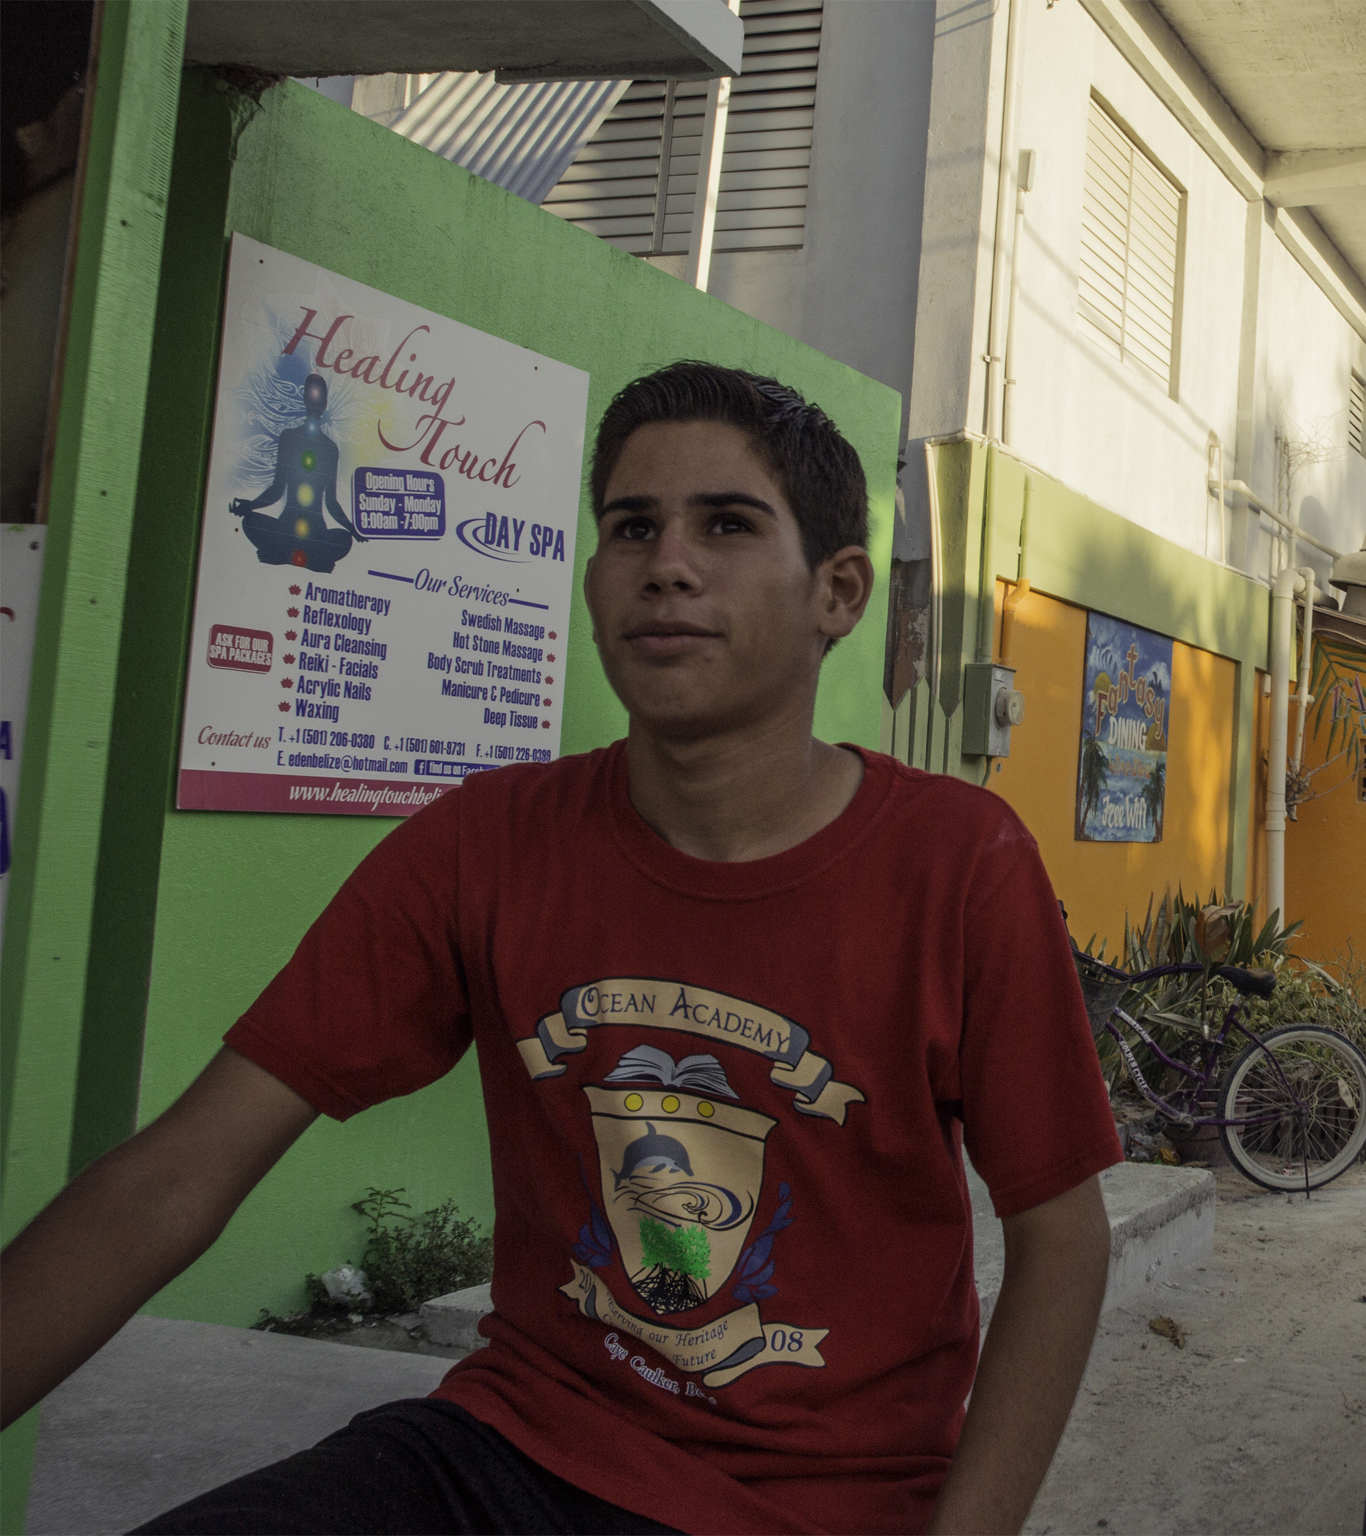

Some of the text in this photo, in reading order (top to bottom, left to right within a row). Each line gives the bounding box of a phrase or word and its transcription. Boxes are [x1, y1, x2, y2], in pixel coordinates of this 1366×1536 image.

[282, 305, 456, 421] Healing
[378, 414, 547, 488] Touch
[366, 472, 434, 492] Opening Hours
[359, 493, 396, 514] Sunday
[404, 495, 441, 514] Monday
[360, 512, 398, 530] 9:00am
[484, 511, 565, 562] DAY SPA
[304, 582, 391, 616] Aromatherapy
[414, 568, 510, 607] Our Services
[303, 605, 371, 635] Reflexology
[461, 609, 545, 640] Swedish Massage
[210, 645, 272, 666] SPA PACKAGES
[215, 633, 269, 652] ASK FOR OUR
[301, 628, 387, 661] Aura Cleansing
[453, 631, 543, 663] Hot Stone Massage
[298, 651, 328, 673] Reiki
[339, 656, 378, 680] Facials
[427, 652, 541, 684] Body Scrub Treatments
[296, 675, 372, 701] Acrylic Nails
[441, 679, 540, 708] Manicure & Pedicure
[1095, 643, 1165, 741] Fantasy
[295, 699, 339, 723] Waxing
[483, 707, 538, 730] Deep Tissue
[198, 725, 271, 749] Contact us
[278, 726, 551, 762] T. +1 (501) 206-0380 C. +1 (501) 601-9731 F. +1 (501) 226-0399
[1108, 715, 1147, 752] DINING
[277, 750, 408, 774] E. edenbelize@hotmail.com
[429, 762, 443, 774] find
[444, 764, 452, 774] us
[452, 765, 461, 775] on
[1101, 794, 1124, 829] Free
[581, 986, 790, 1054] OCEAN ACADEMY
[1118, 1040, 1139, 1069] GOLDEN
[578, 1269, 592, 1294] 20
[648, 1332, 669, 1344] our
[675, 1320, 729, 1347] Heritage
[769, 1330, 804, 1353] 08
[604, 1332, 629, 1361] Caye
[629, 1356, 681, 1394] Caulker,
[672, 1349, 717, 1367] Future
